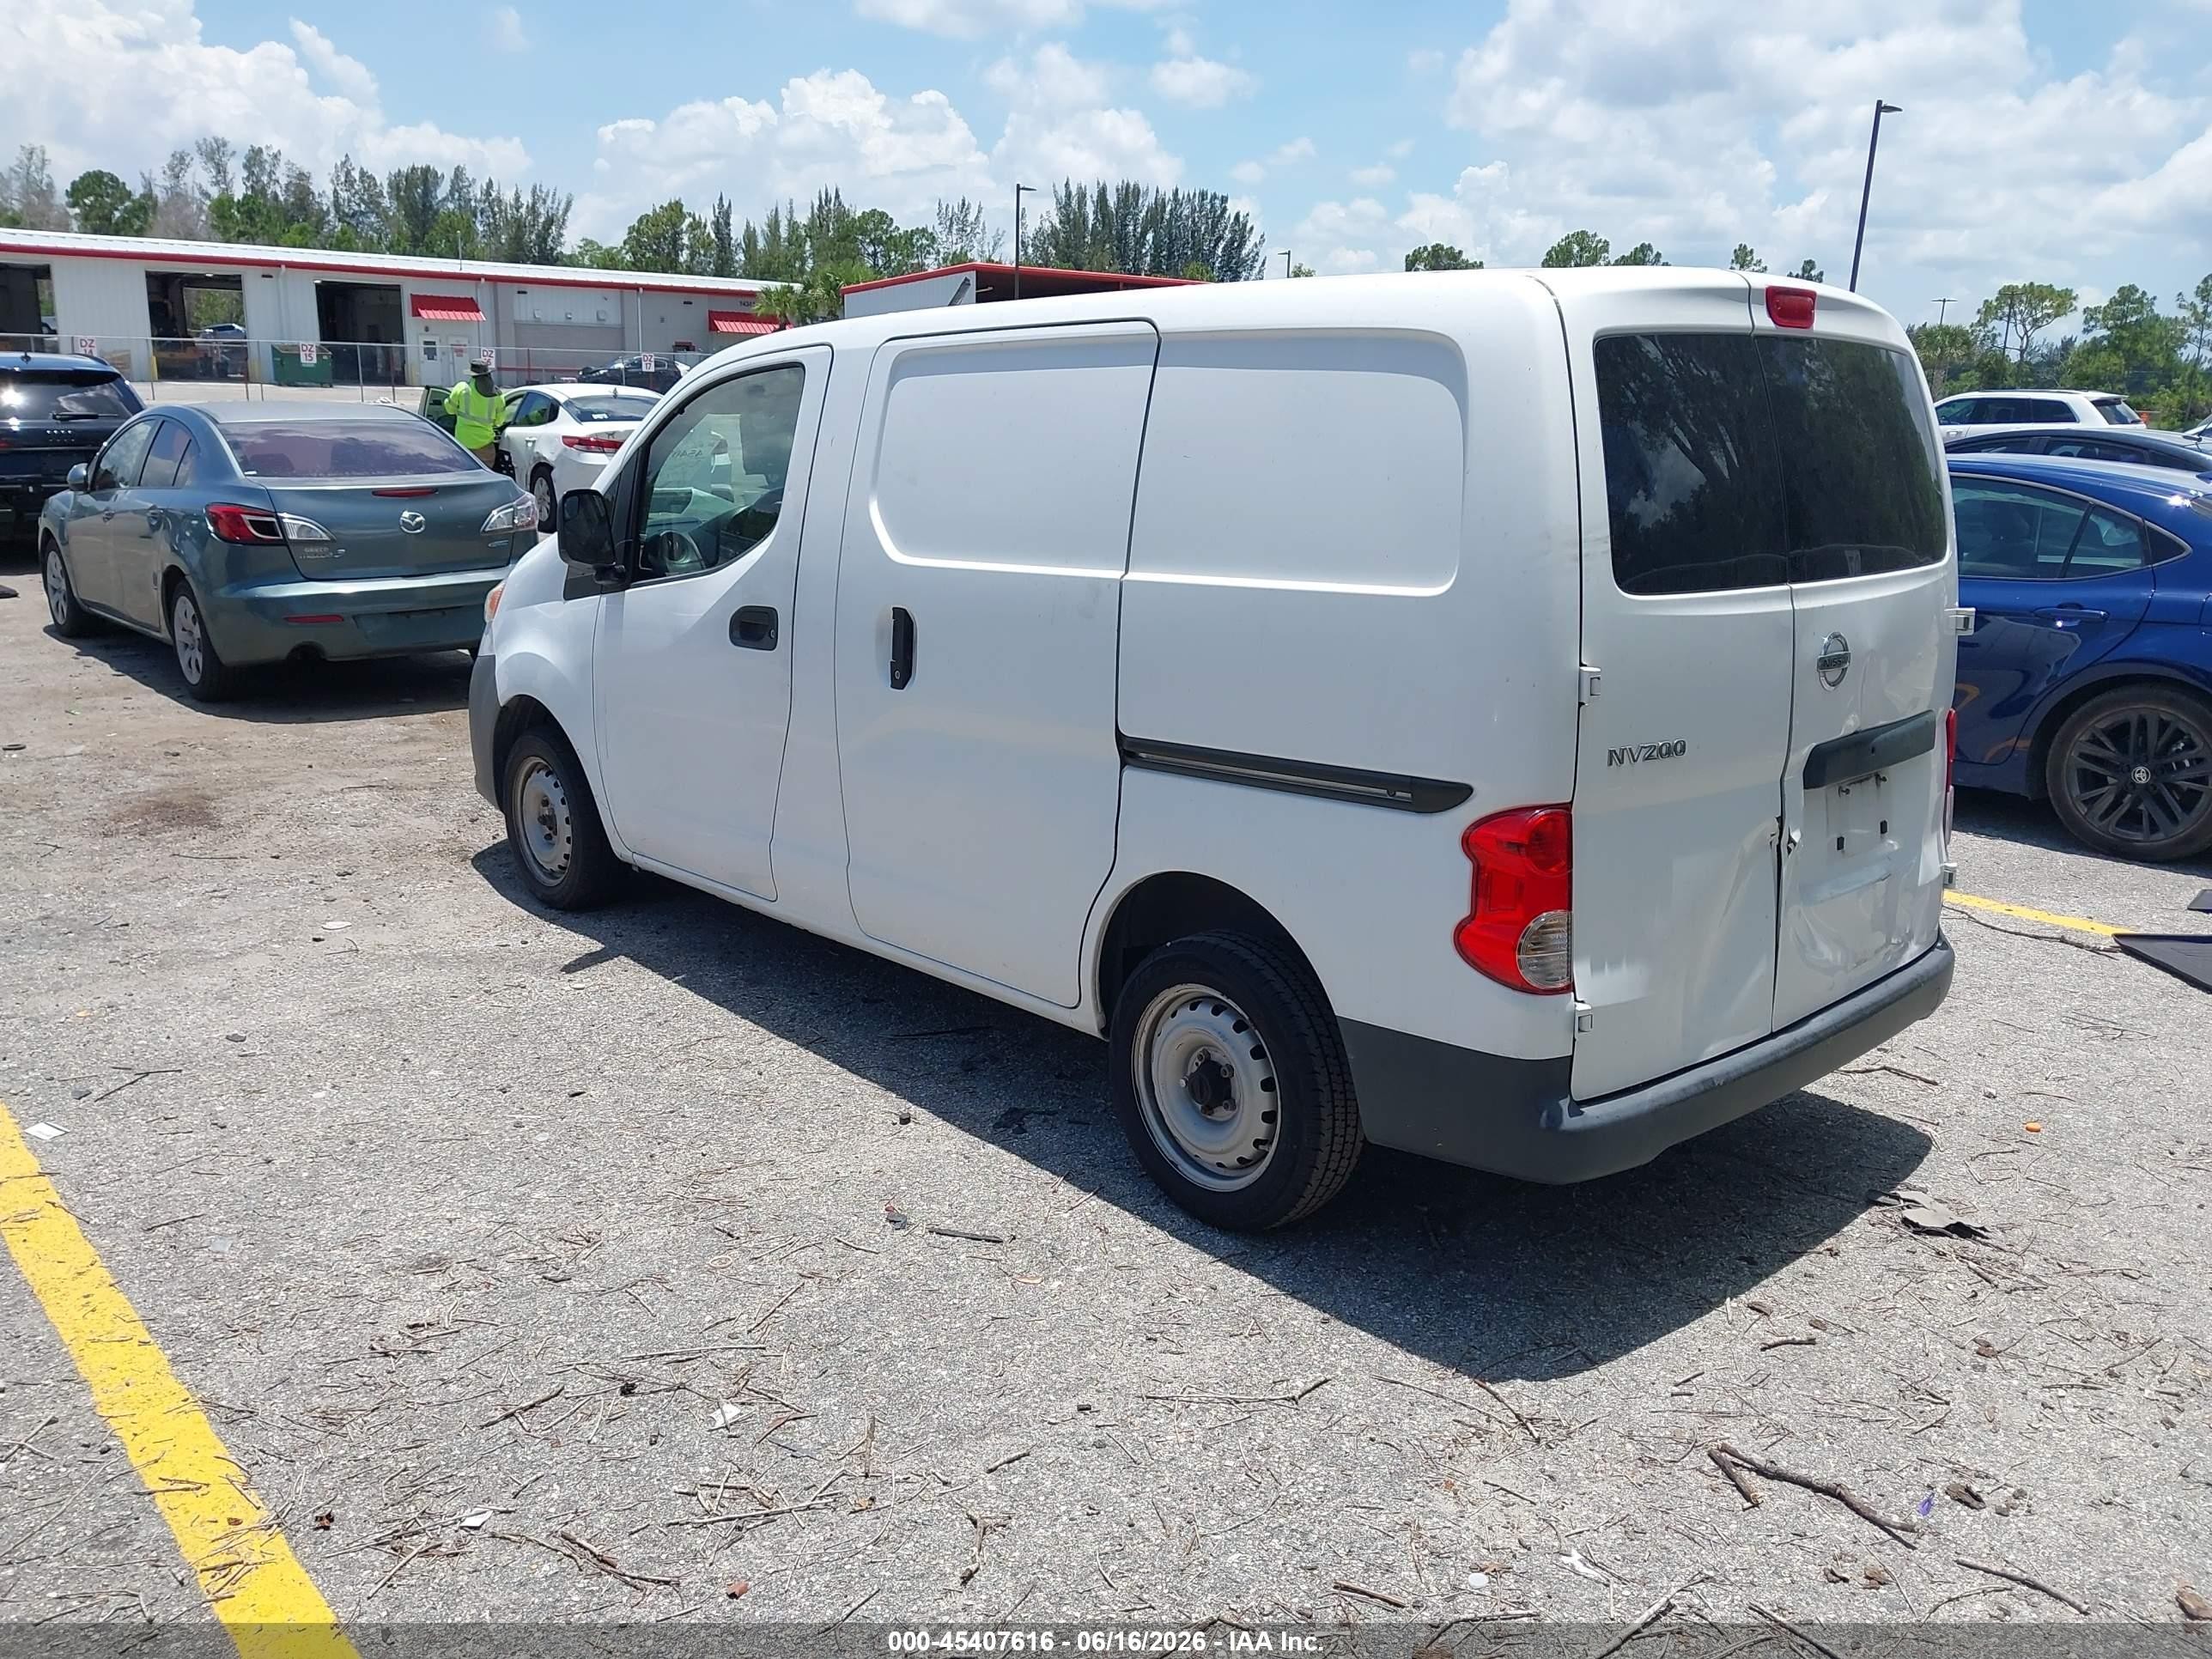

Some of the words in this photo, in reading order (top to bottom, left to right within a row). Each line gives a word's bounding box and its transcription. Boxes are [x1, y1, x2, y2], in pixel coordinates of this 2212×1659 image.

[80, 338, 95, 349] DZ
[301, 343, 314, 352] DZ
[304, 353, 313, 362] 15
[482, 349, 494, 358] DZ
[642, 354, 653, 362] DZ
[1607, 738, 1687, 767] NV200
